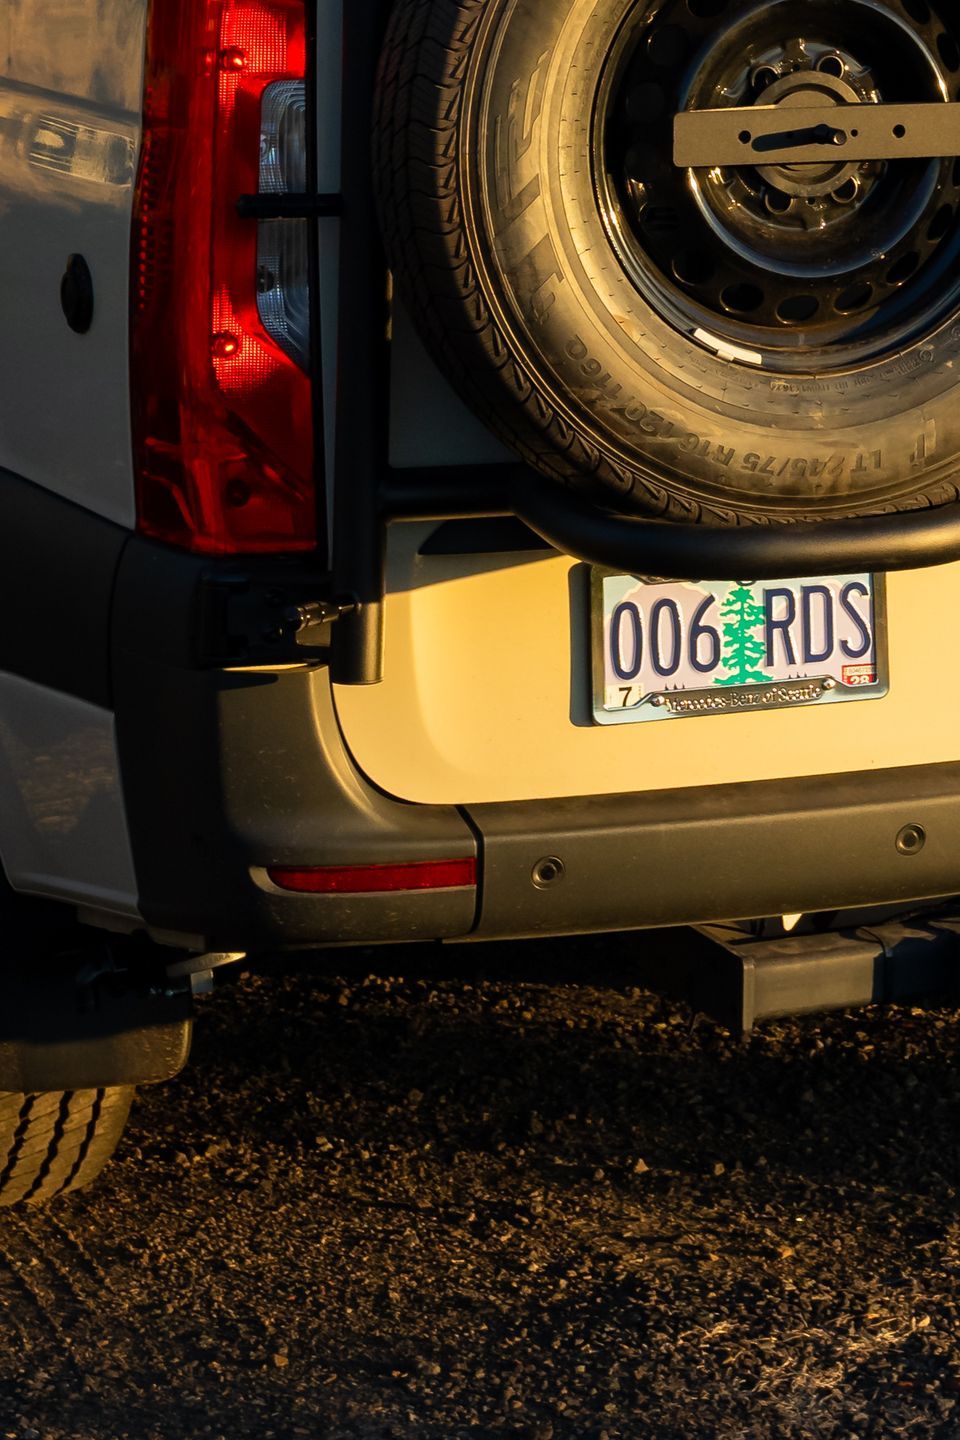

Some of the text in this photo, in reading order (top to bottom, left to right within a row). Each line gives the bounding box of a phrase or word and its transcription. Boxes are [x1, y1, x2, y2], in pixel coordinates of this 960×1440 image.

[678, 432, 736, 467] R16
[851, 448, 883, 472] LT
[740, 451, 846, 478] 245/75
[610, 580, 872, 681] 006 RDS
[618, 686, 633, 707] 7
[666, 684, 821, 713] Mercedes-Benz of Seattle
